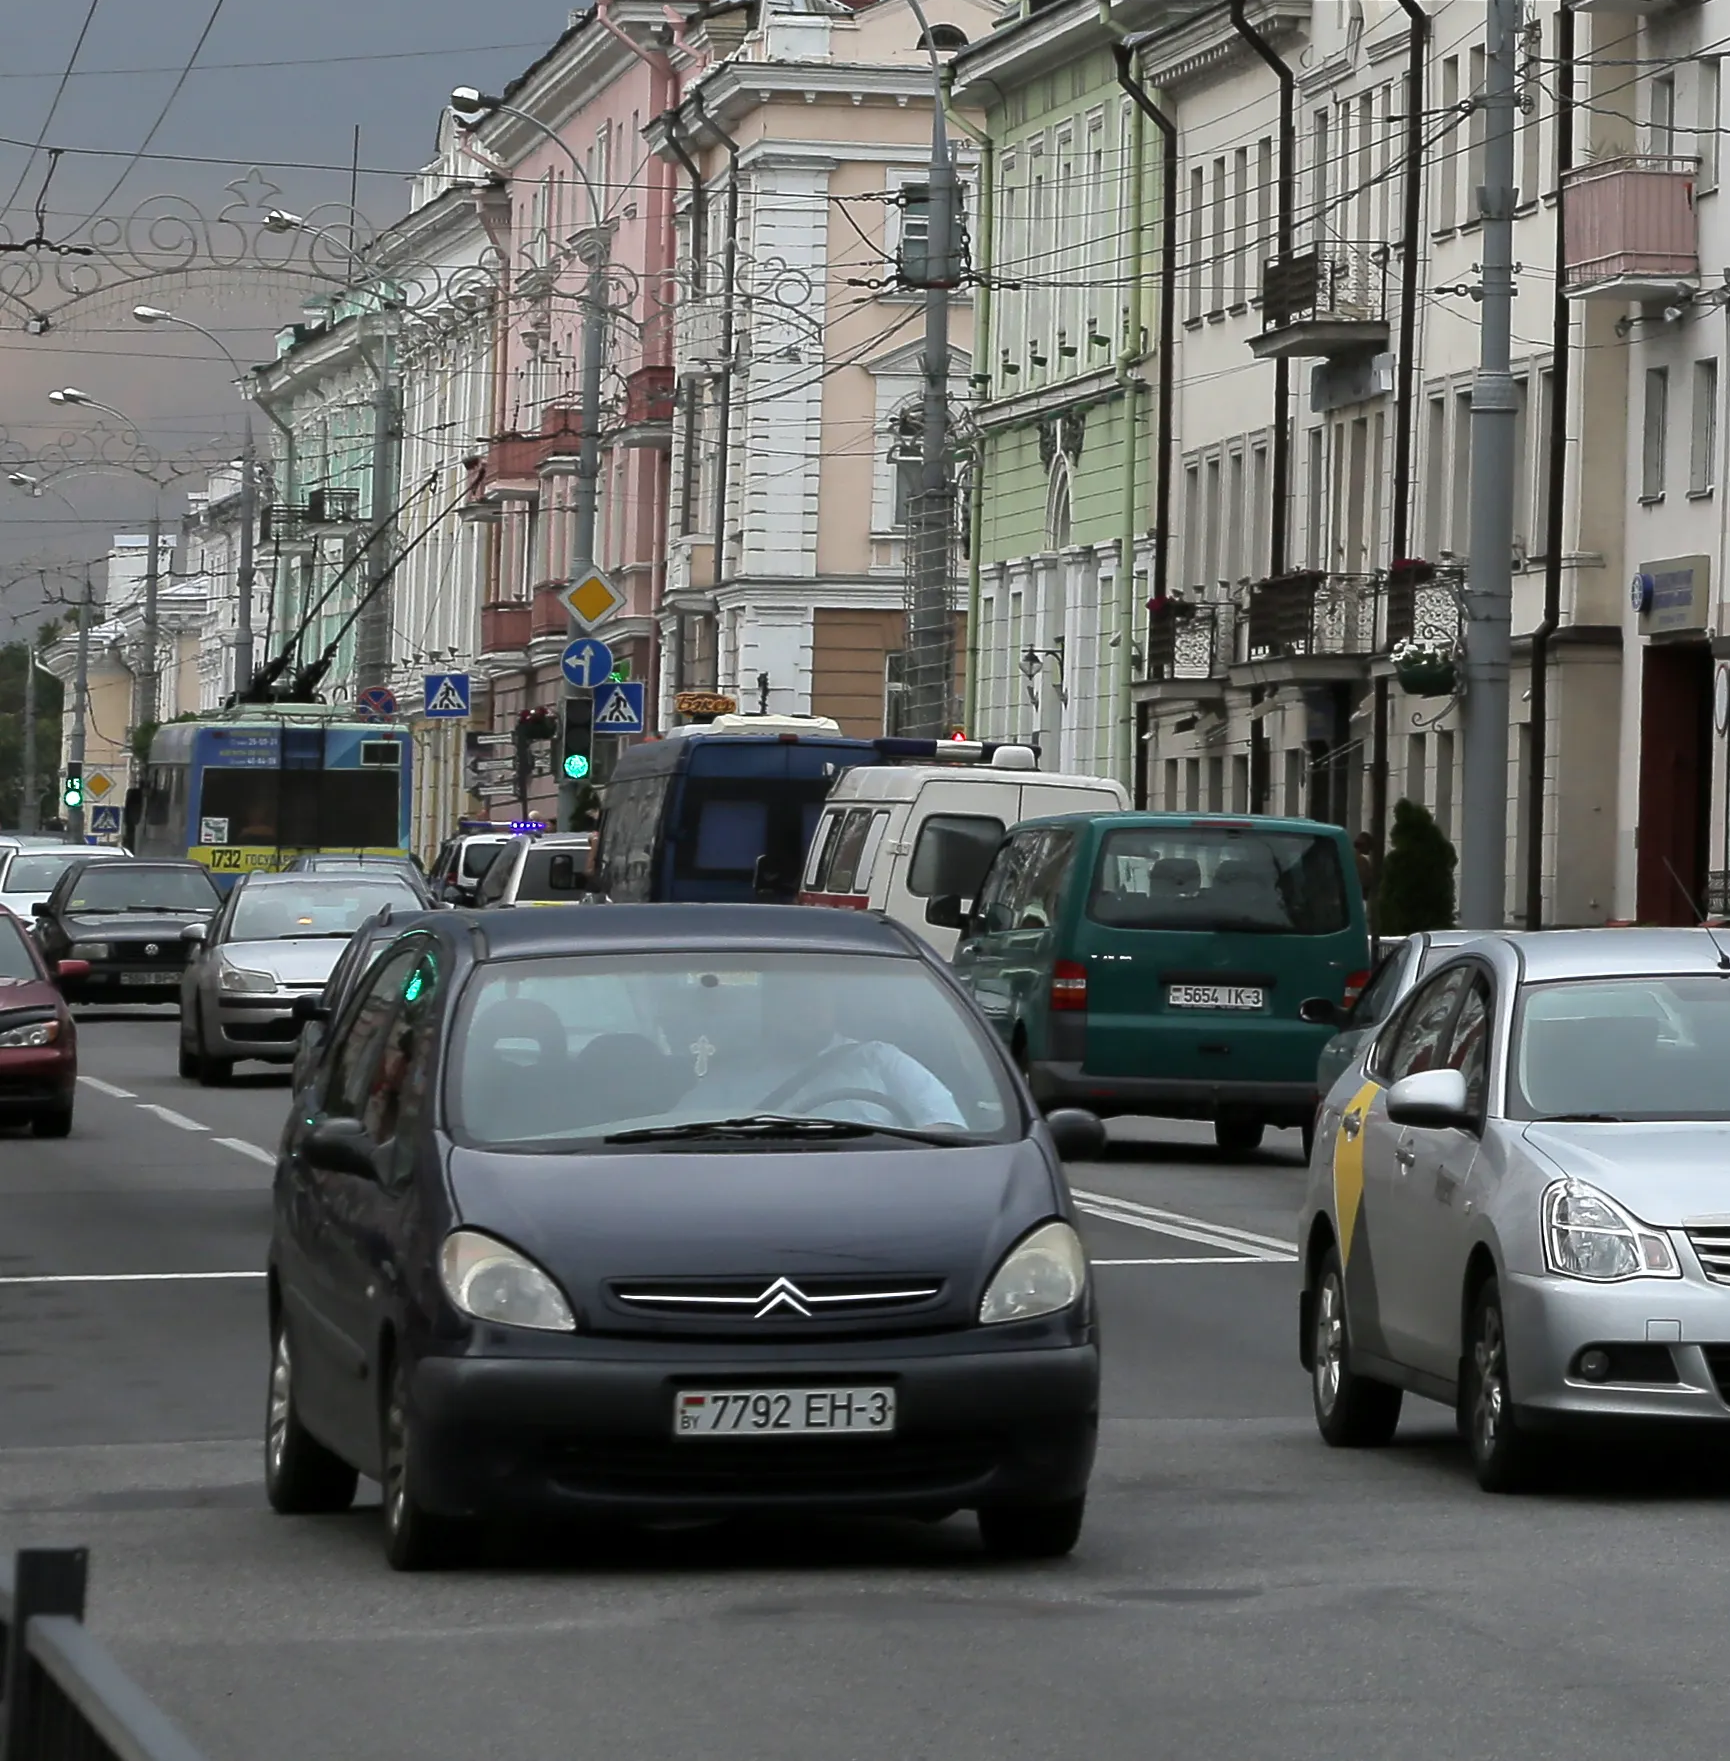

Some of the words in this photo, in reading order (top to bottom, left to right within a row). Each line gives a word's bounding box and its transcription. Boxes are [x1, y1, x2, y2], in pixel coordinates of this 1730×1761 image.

[211, 849, 241, 869] 1732
[1184, 987, 1219, 1004] 5654
[1227, 988, 1261, 1006] IK-3
[680, 1414, 701, 1430] BY
[710, 1394, 791, 1430] 7792
[804, 1391, 888, 1428] EH-3
